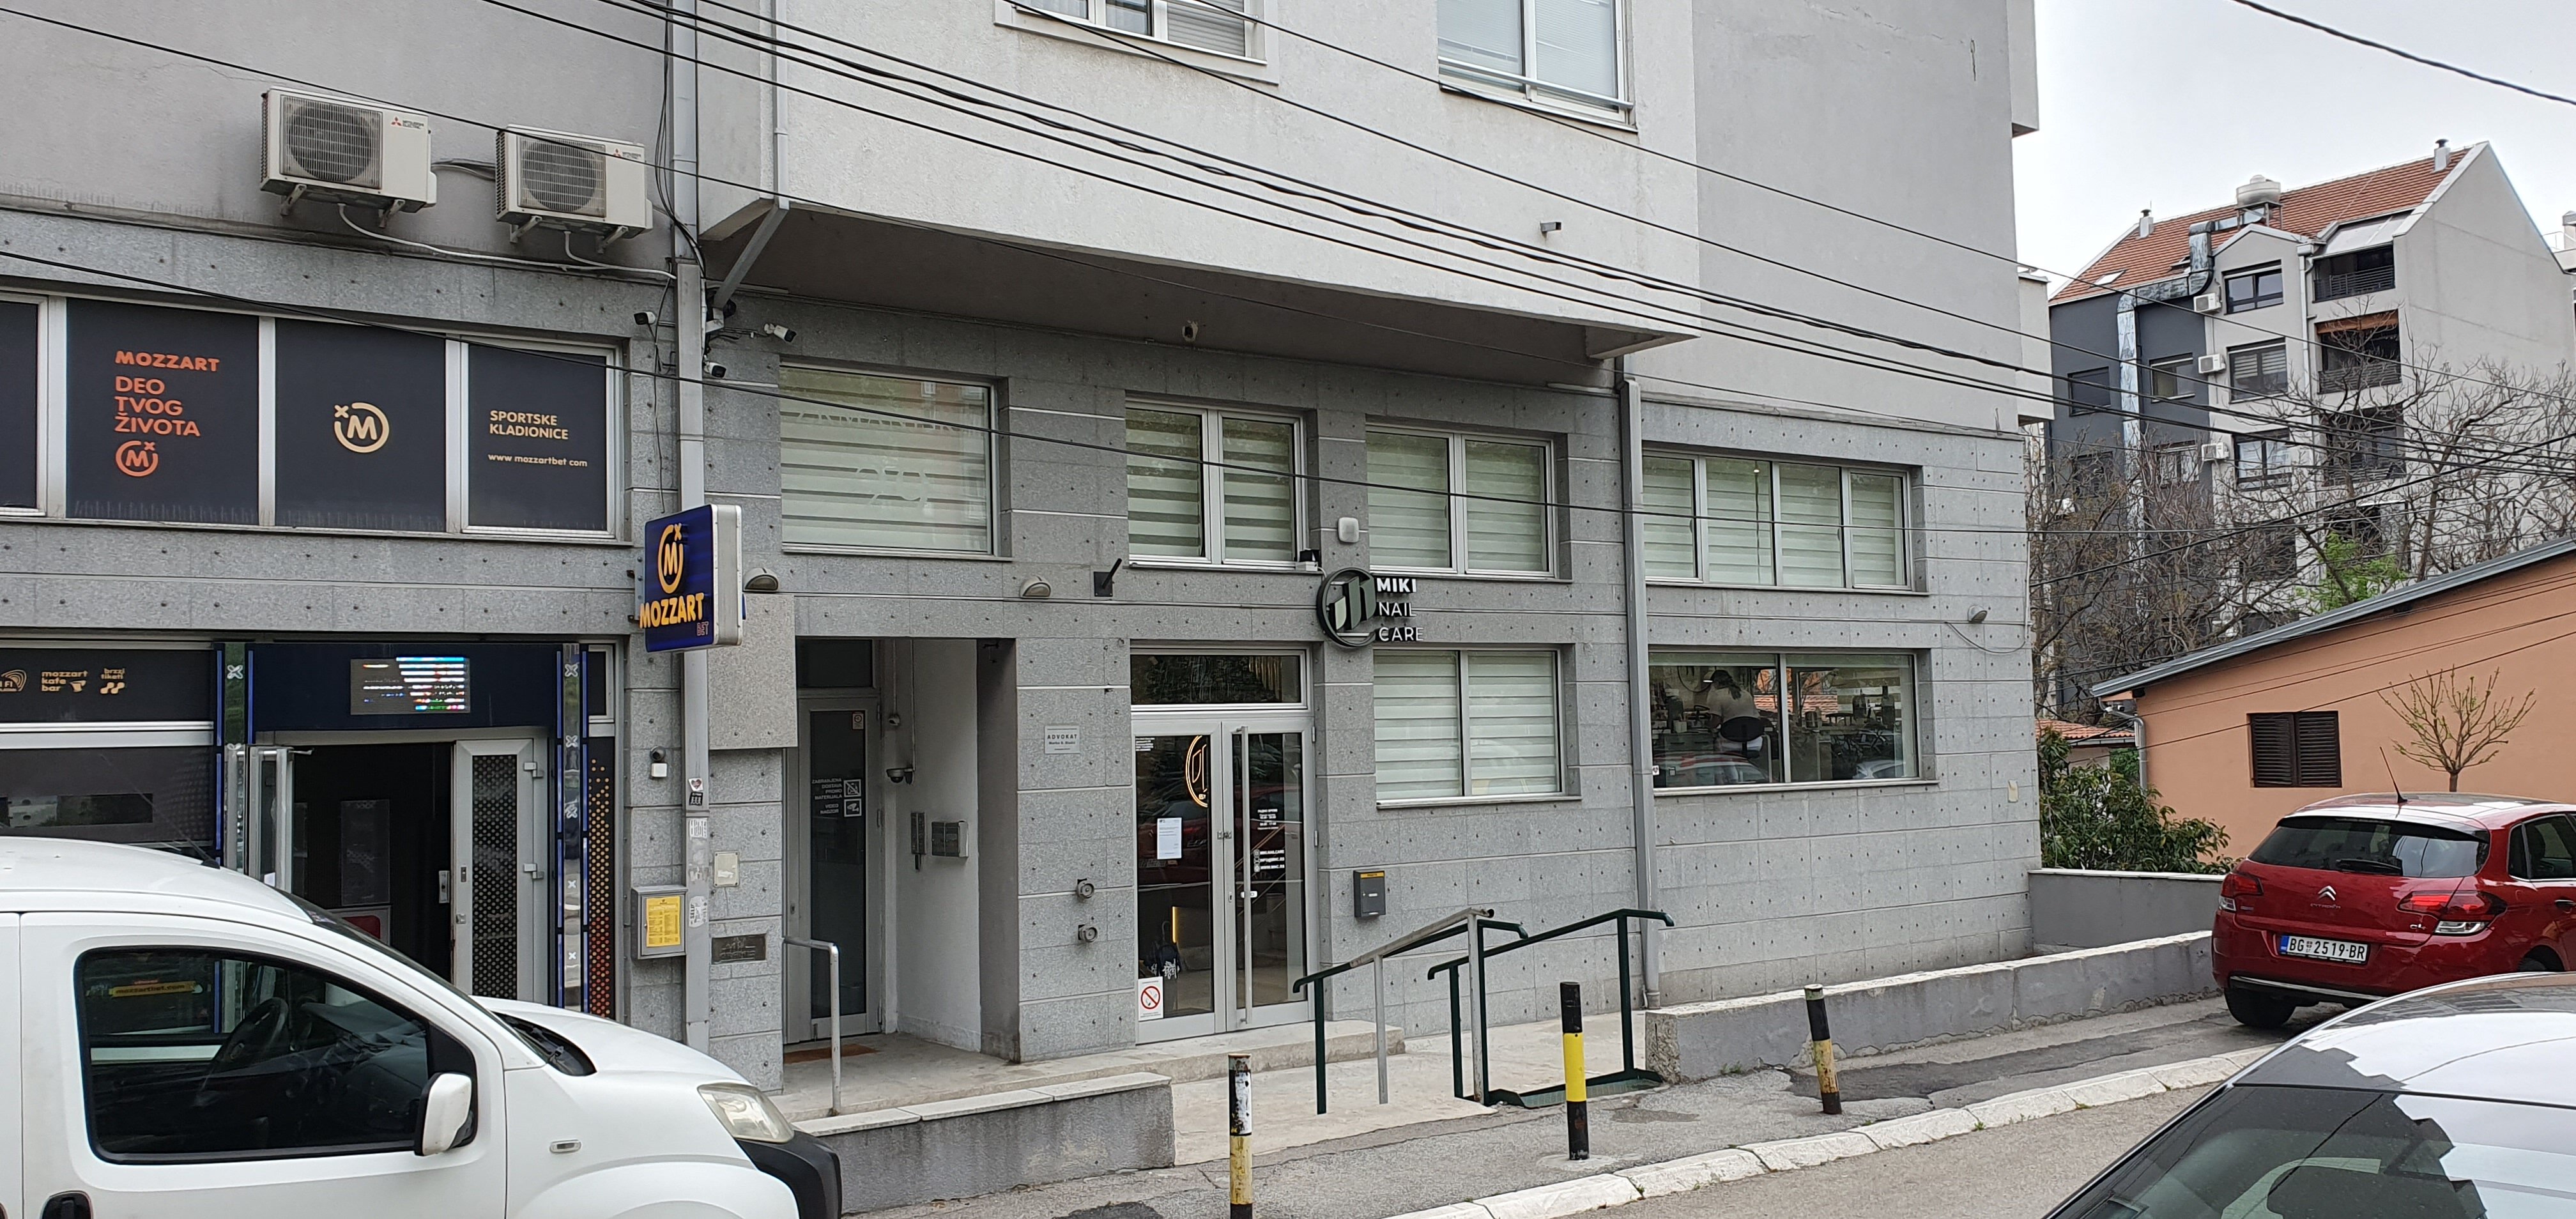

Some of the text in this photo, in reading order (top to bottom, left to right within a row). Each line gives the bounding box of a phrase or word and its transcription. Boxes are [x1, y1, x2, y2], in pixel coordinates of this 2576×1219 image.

[115, 351, 220, 372] MOZZART
[116, 376, 165, 395] DEO
[114, 396, 183, 416] TVOG
[114, 412, 201, 437] ŽIVOTA
[490, 410, 558, 426] SPORTSKE
[489, 424, 569, 440] KLADIONICE
[1376, 578, 1417, 593] MIKI
[640, 592, 704, 629] MOZZART
[1379, 601, 1417, 617] NAIL
[1378, 627, 1424, 642] CARE
[2289, 938, 2304, 951] BG
